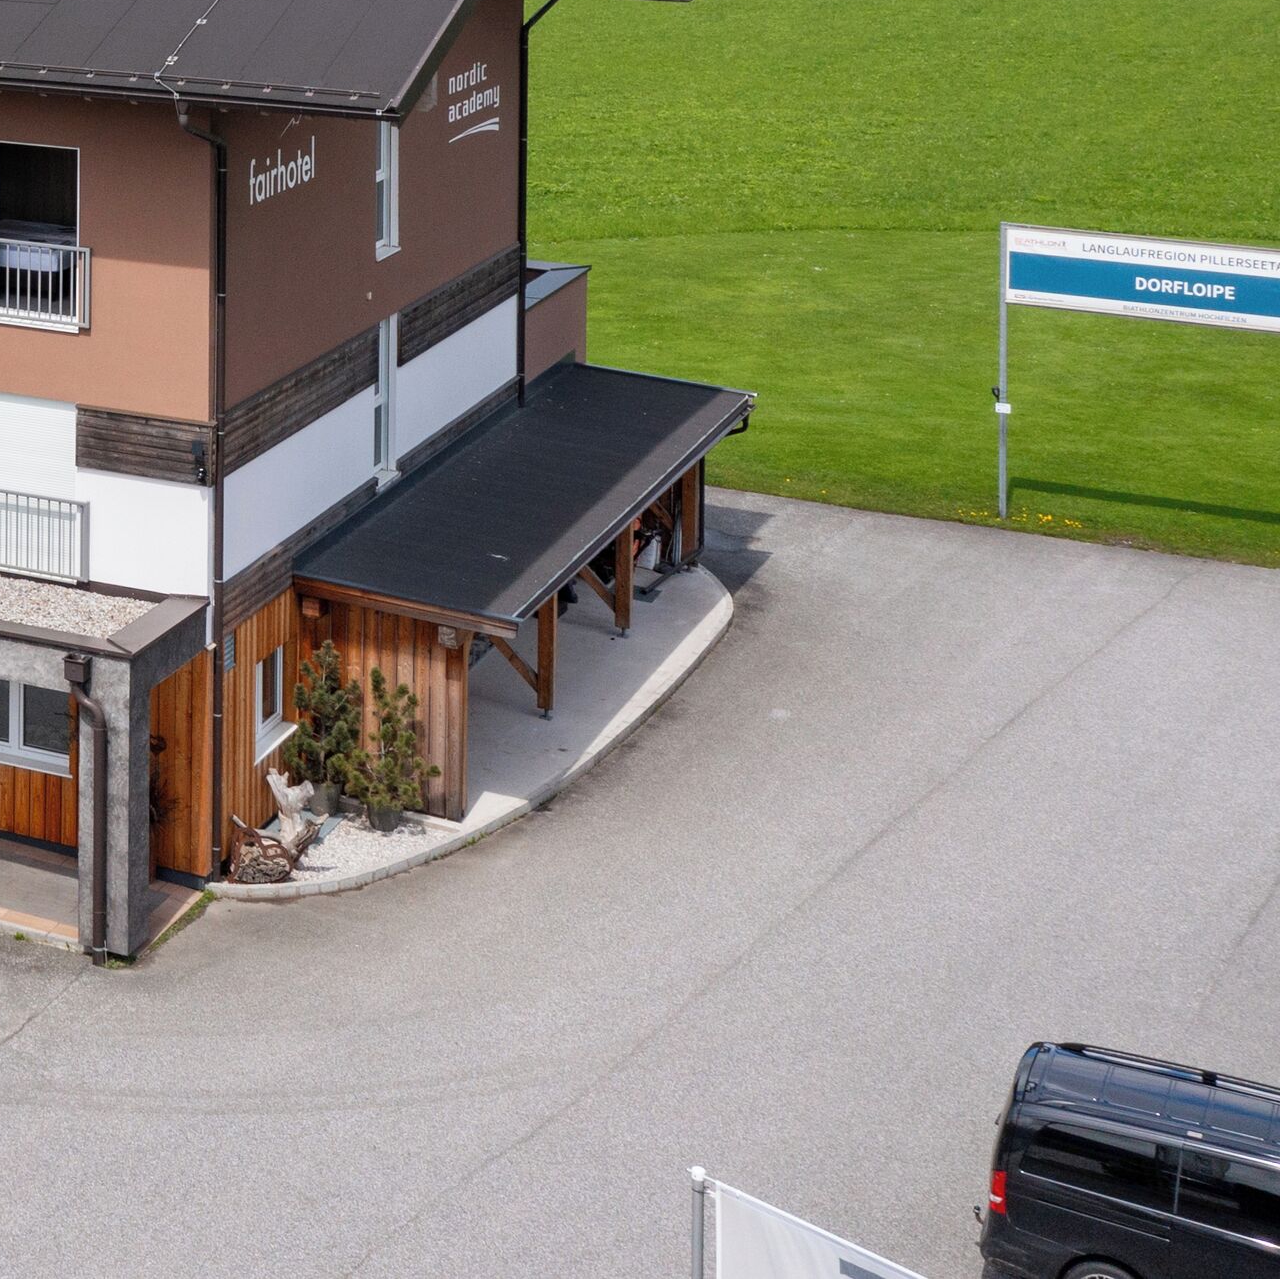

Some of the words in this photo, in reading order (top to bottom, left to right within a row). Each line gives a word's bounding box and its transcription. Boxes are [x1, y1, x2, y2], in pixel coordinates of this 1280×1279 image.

[448, 62, 488, 95] nordic
[448, 85, 501, 123] academy
[249, 135, 315, 205] fairhotel
[1082, 242, 1197, 263] LANGLAUFREGION
[1135, 276, 1236, 301] DORFLOIPE
